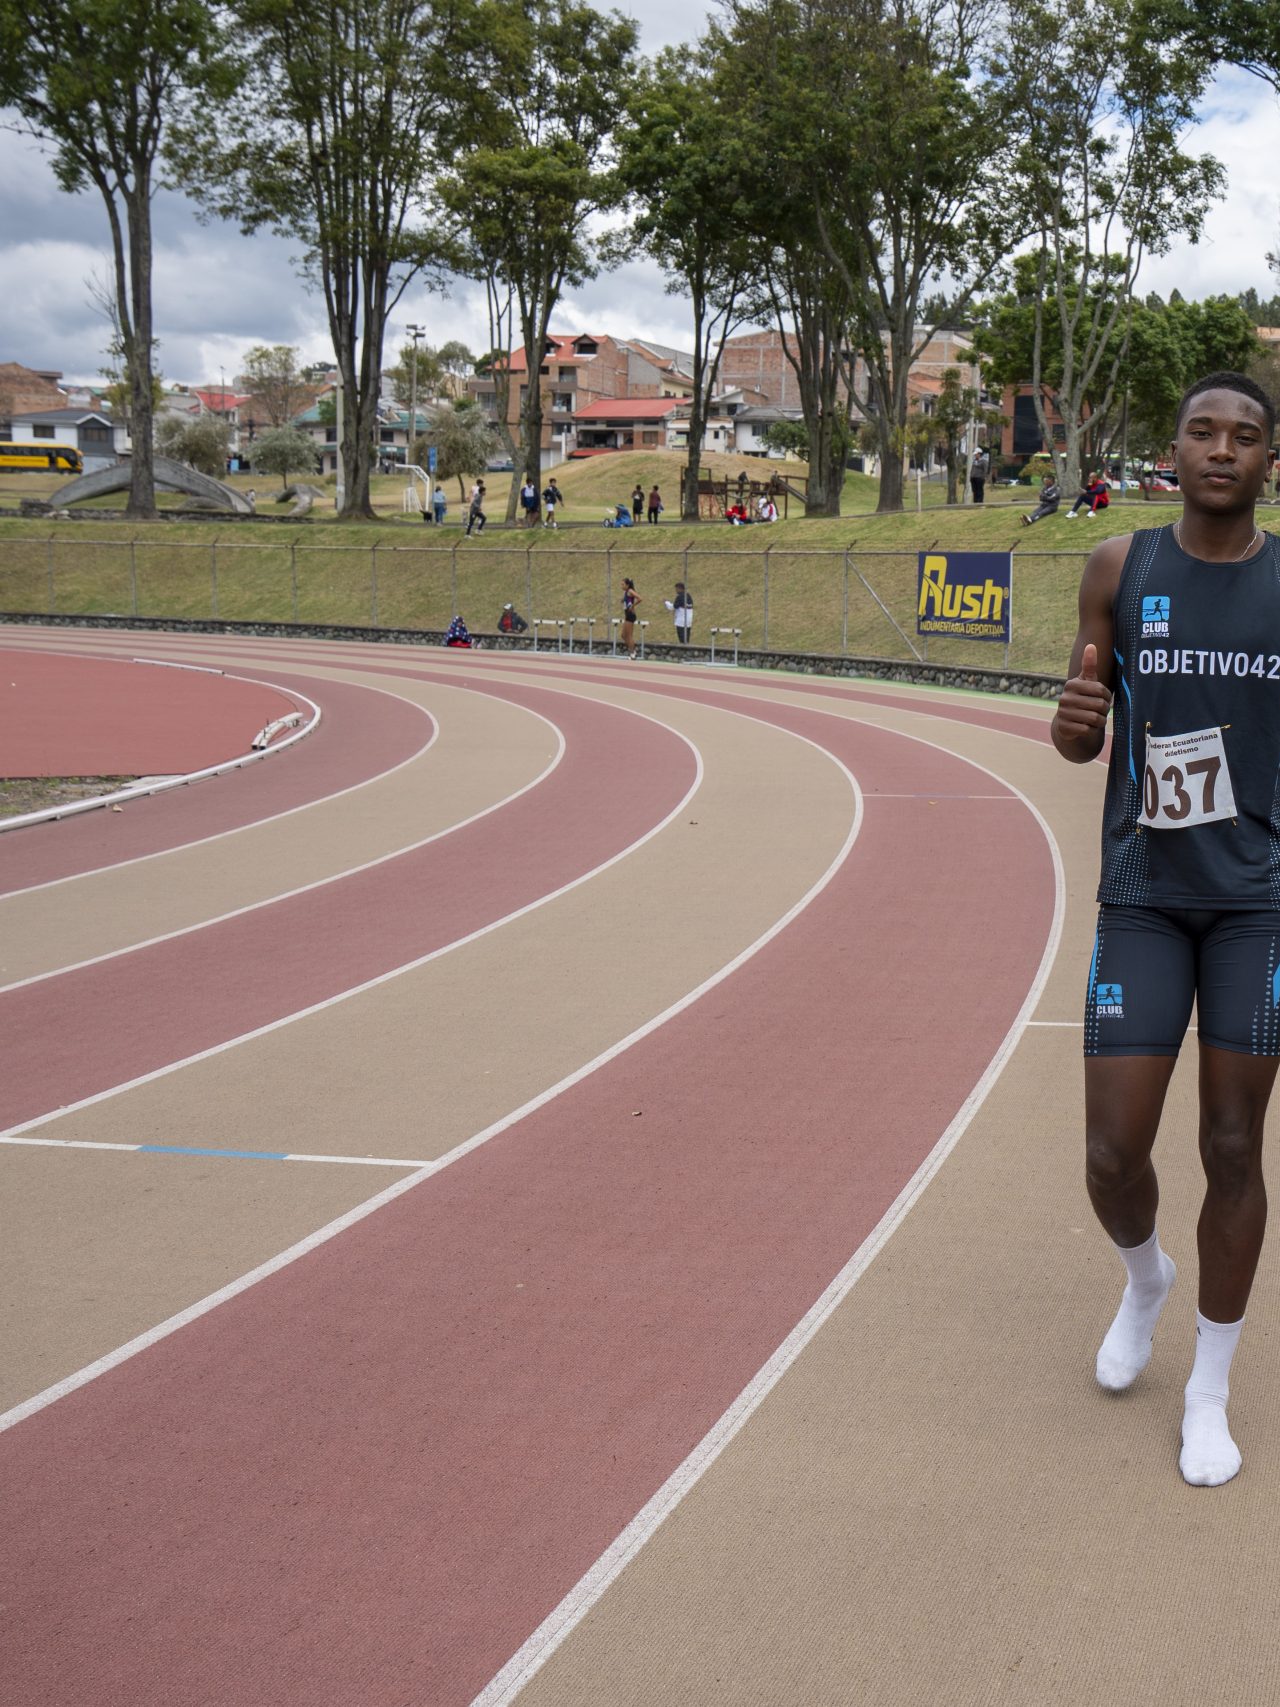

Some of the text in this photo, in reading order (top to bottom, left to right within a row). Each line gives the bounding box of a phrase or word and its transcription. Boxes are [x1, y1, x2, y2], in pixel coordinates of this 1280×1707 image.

[918, 556, 1003, 620] Rush
[920, 620, 1005, 636] INDUMENTARIA DEPORTIVA
[1142, 622, 1169, 633] CLUB
[1139, 650, 1280, 679] OBJETIVO42
[1172, 733, 1218, 747] Ecuatoriana
[1097, 1005, 1122, 1014] CLUB
